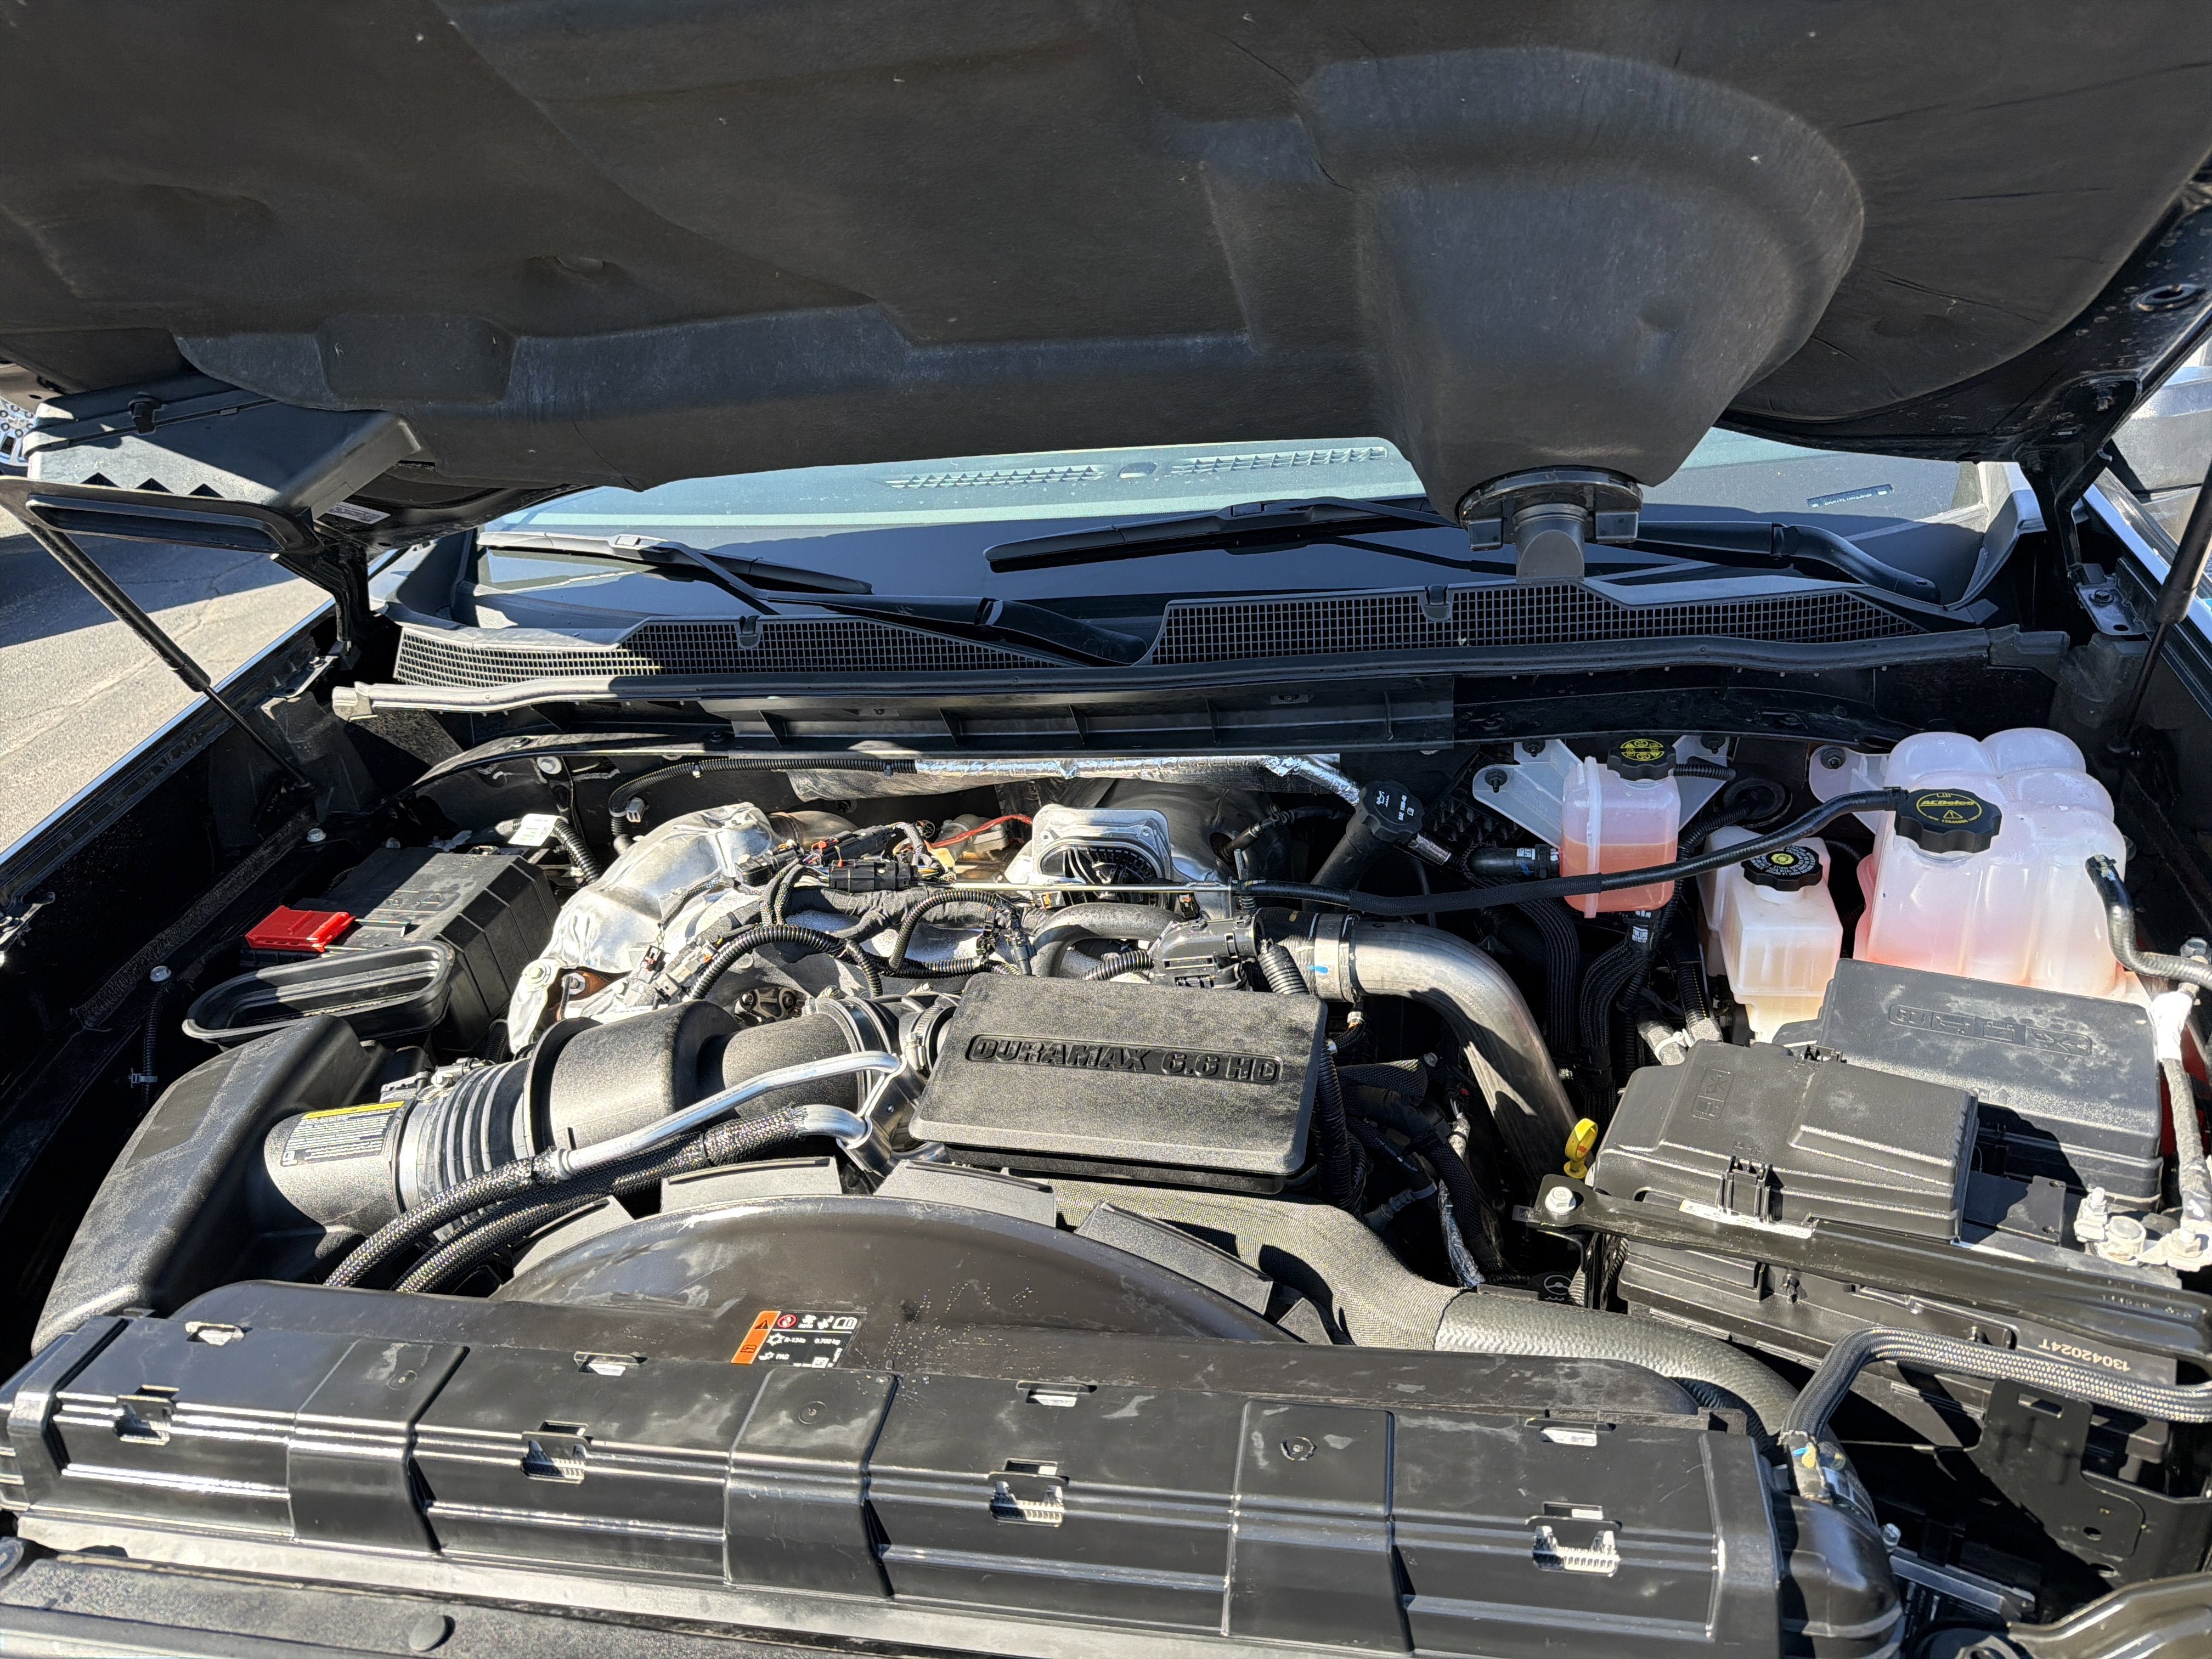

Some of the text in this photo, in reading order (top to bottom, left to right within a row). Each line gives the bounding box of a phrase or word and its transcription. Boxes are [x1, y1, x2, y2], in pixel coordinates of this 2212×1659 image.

[971, 1038, 1280, 1082] DURAMAX 6.6 HD
[2038, 1339, 2131, 1372] 13042024T
